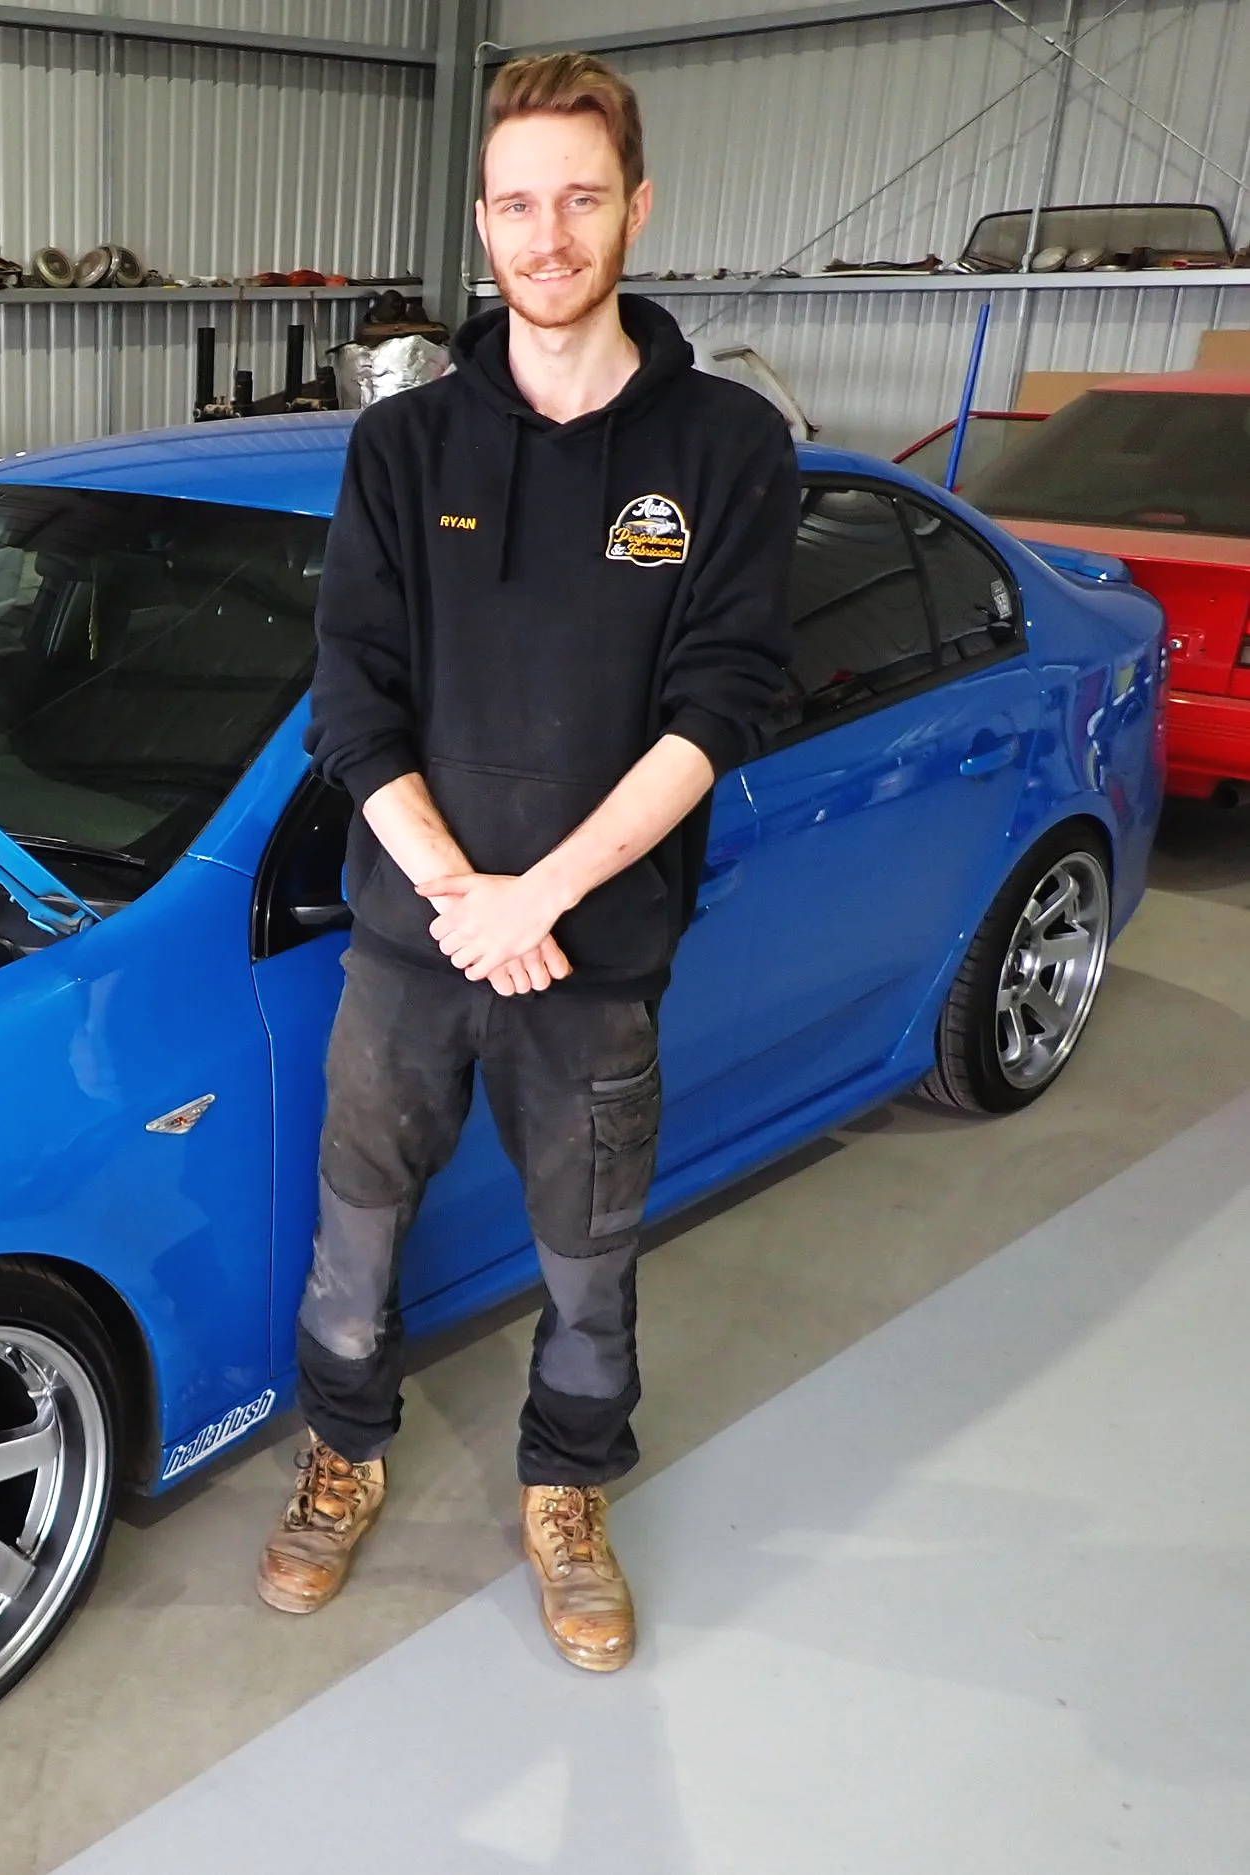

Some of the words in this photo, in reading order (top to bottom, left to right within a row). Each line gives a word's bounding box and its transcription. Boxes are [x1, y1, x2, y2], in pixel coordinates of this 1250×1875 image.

[631, 498, 673, 519] Auto
[440, 515, 478, 530] RYAN
[614, 527, 684, 547] Performance
[610, 543, 626, 556] &
[625, 543, 682, 559] Fabrication
[164, 1391, 275, 1478] hellaflush
